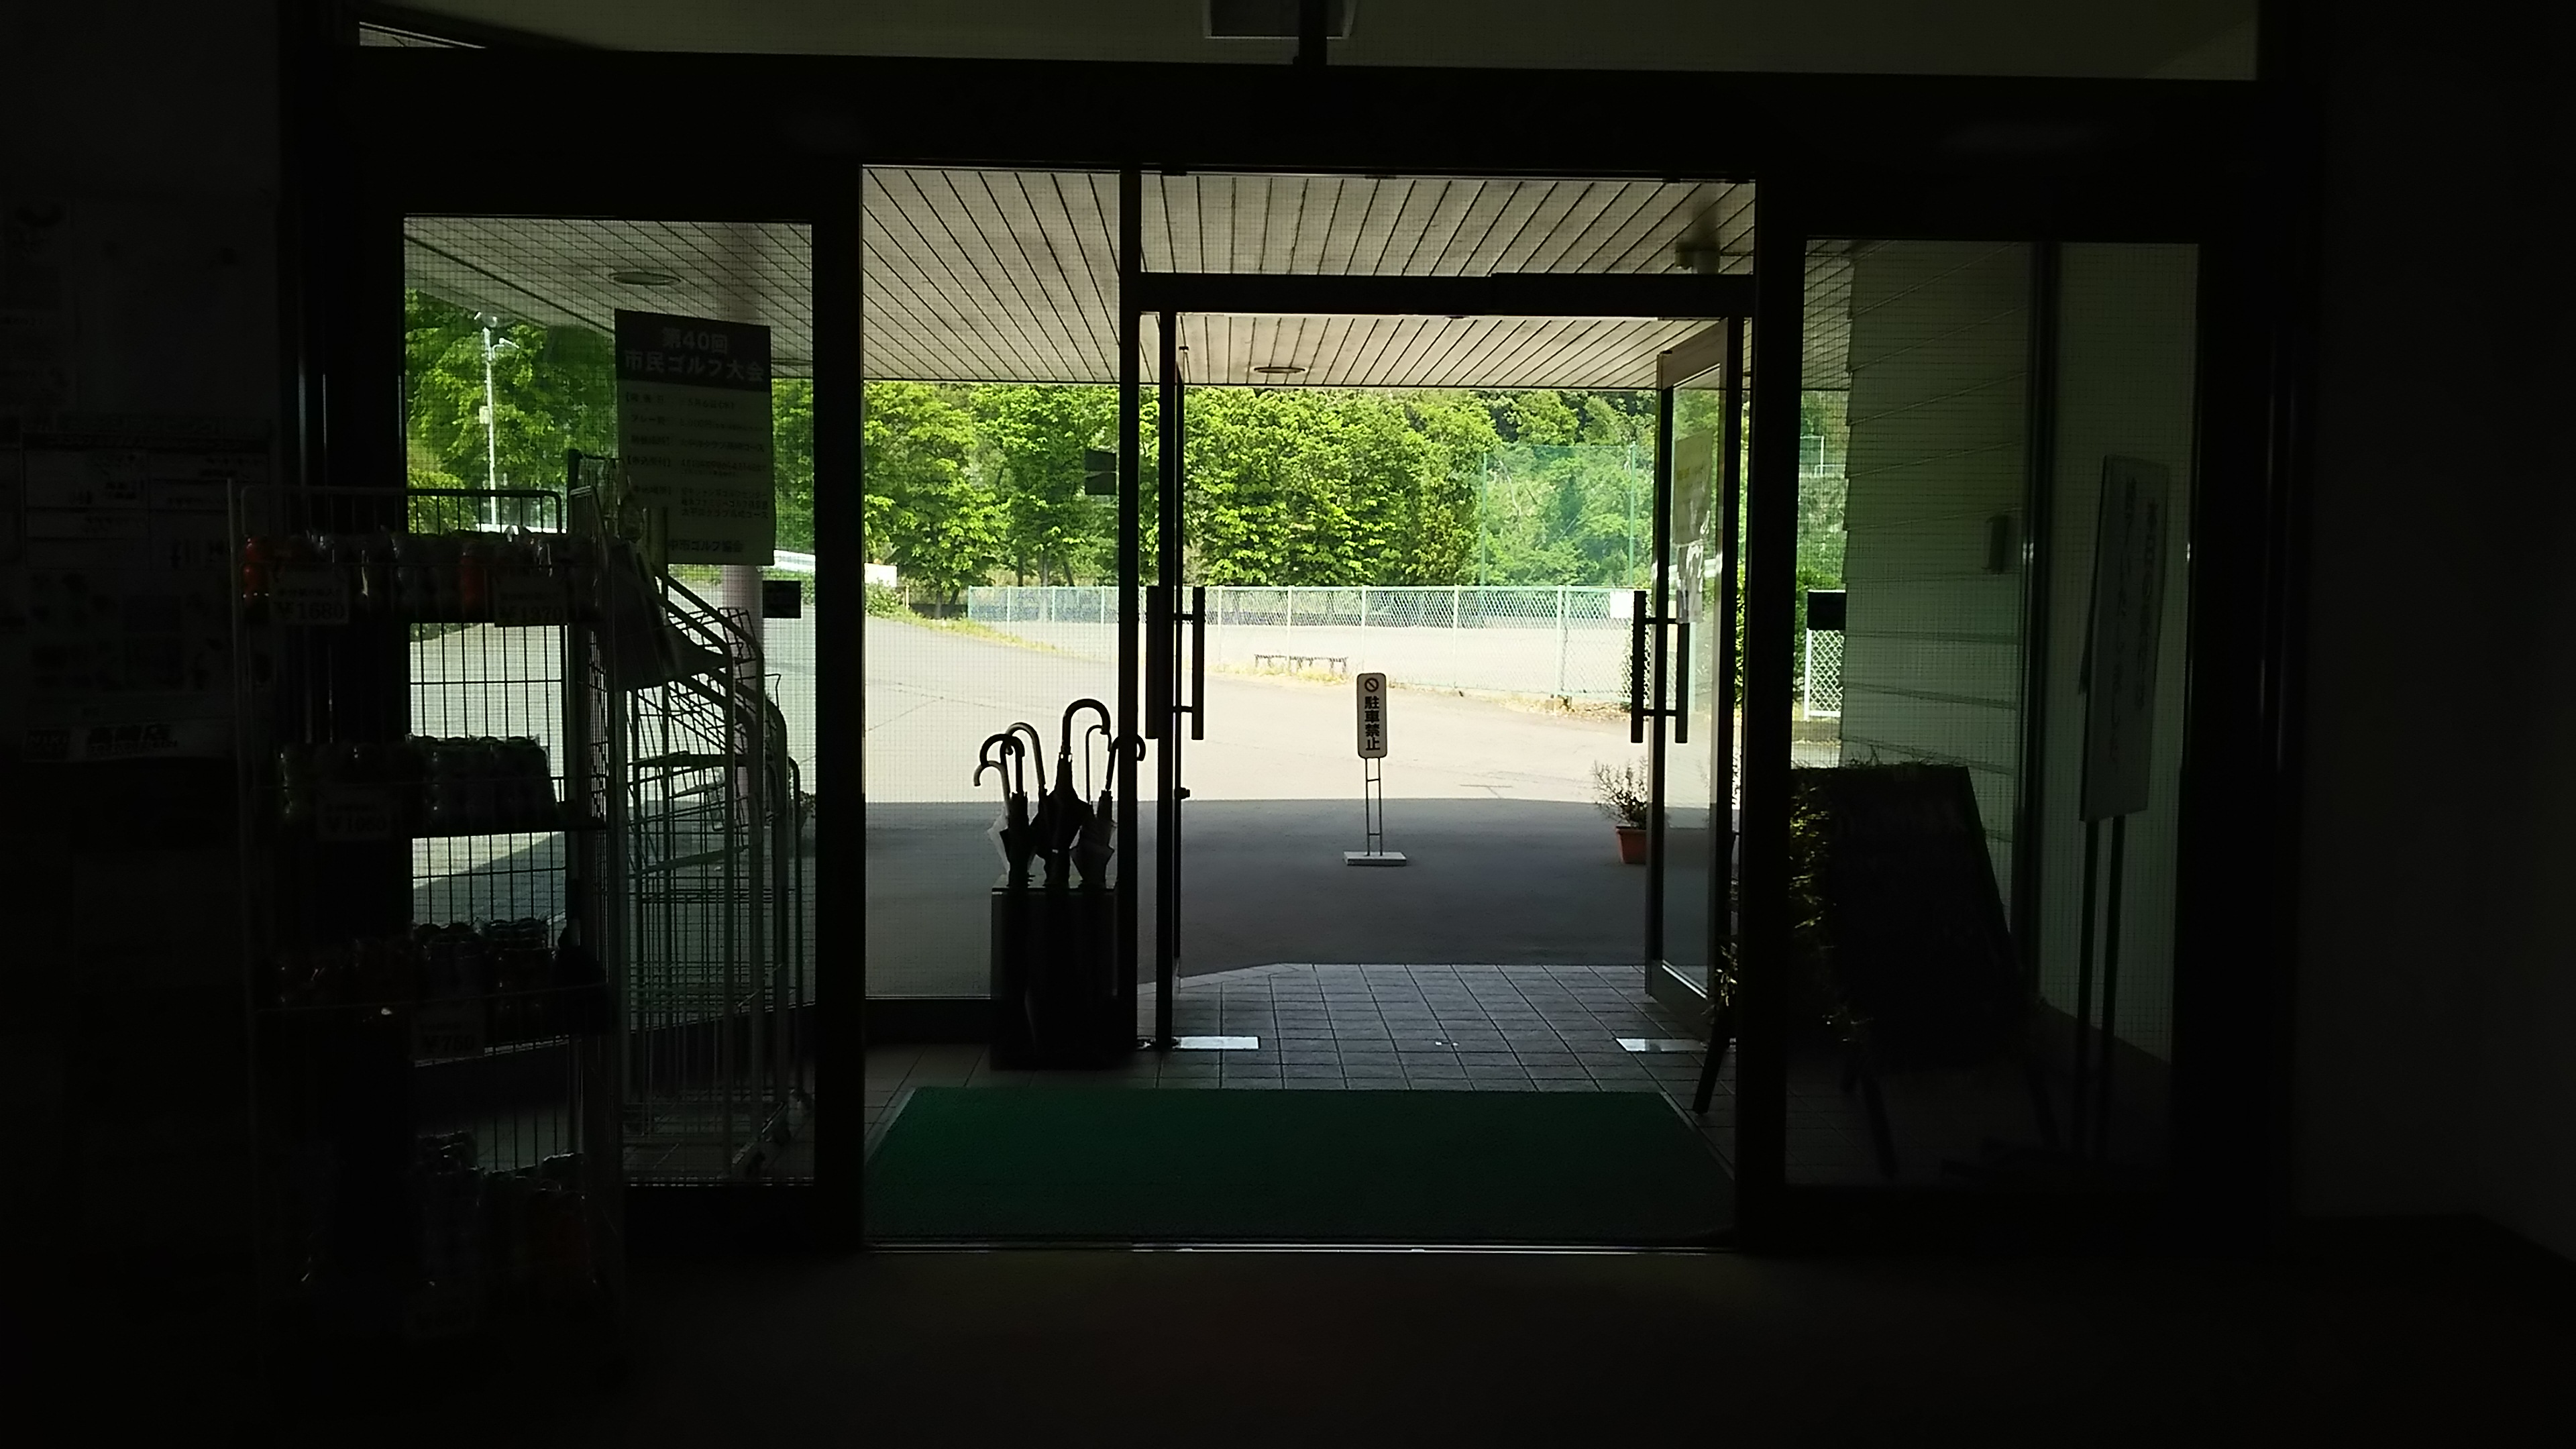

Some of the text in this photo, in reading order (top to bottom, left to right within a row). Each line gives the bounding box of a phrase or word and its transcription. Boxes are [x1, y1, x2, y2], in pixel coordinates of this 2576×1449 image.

[661, 327, 728, 354] 第40回
[624, 349, 765, 382] 市民ゴルフ大会
[1364, 696, 1381, 751] 駐車禁止
